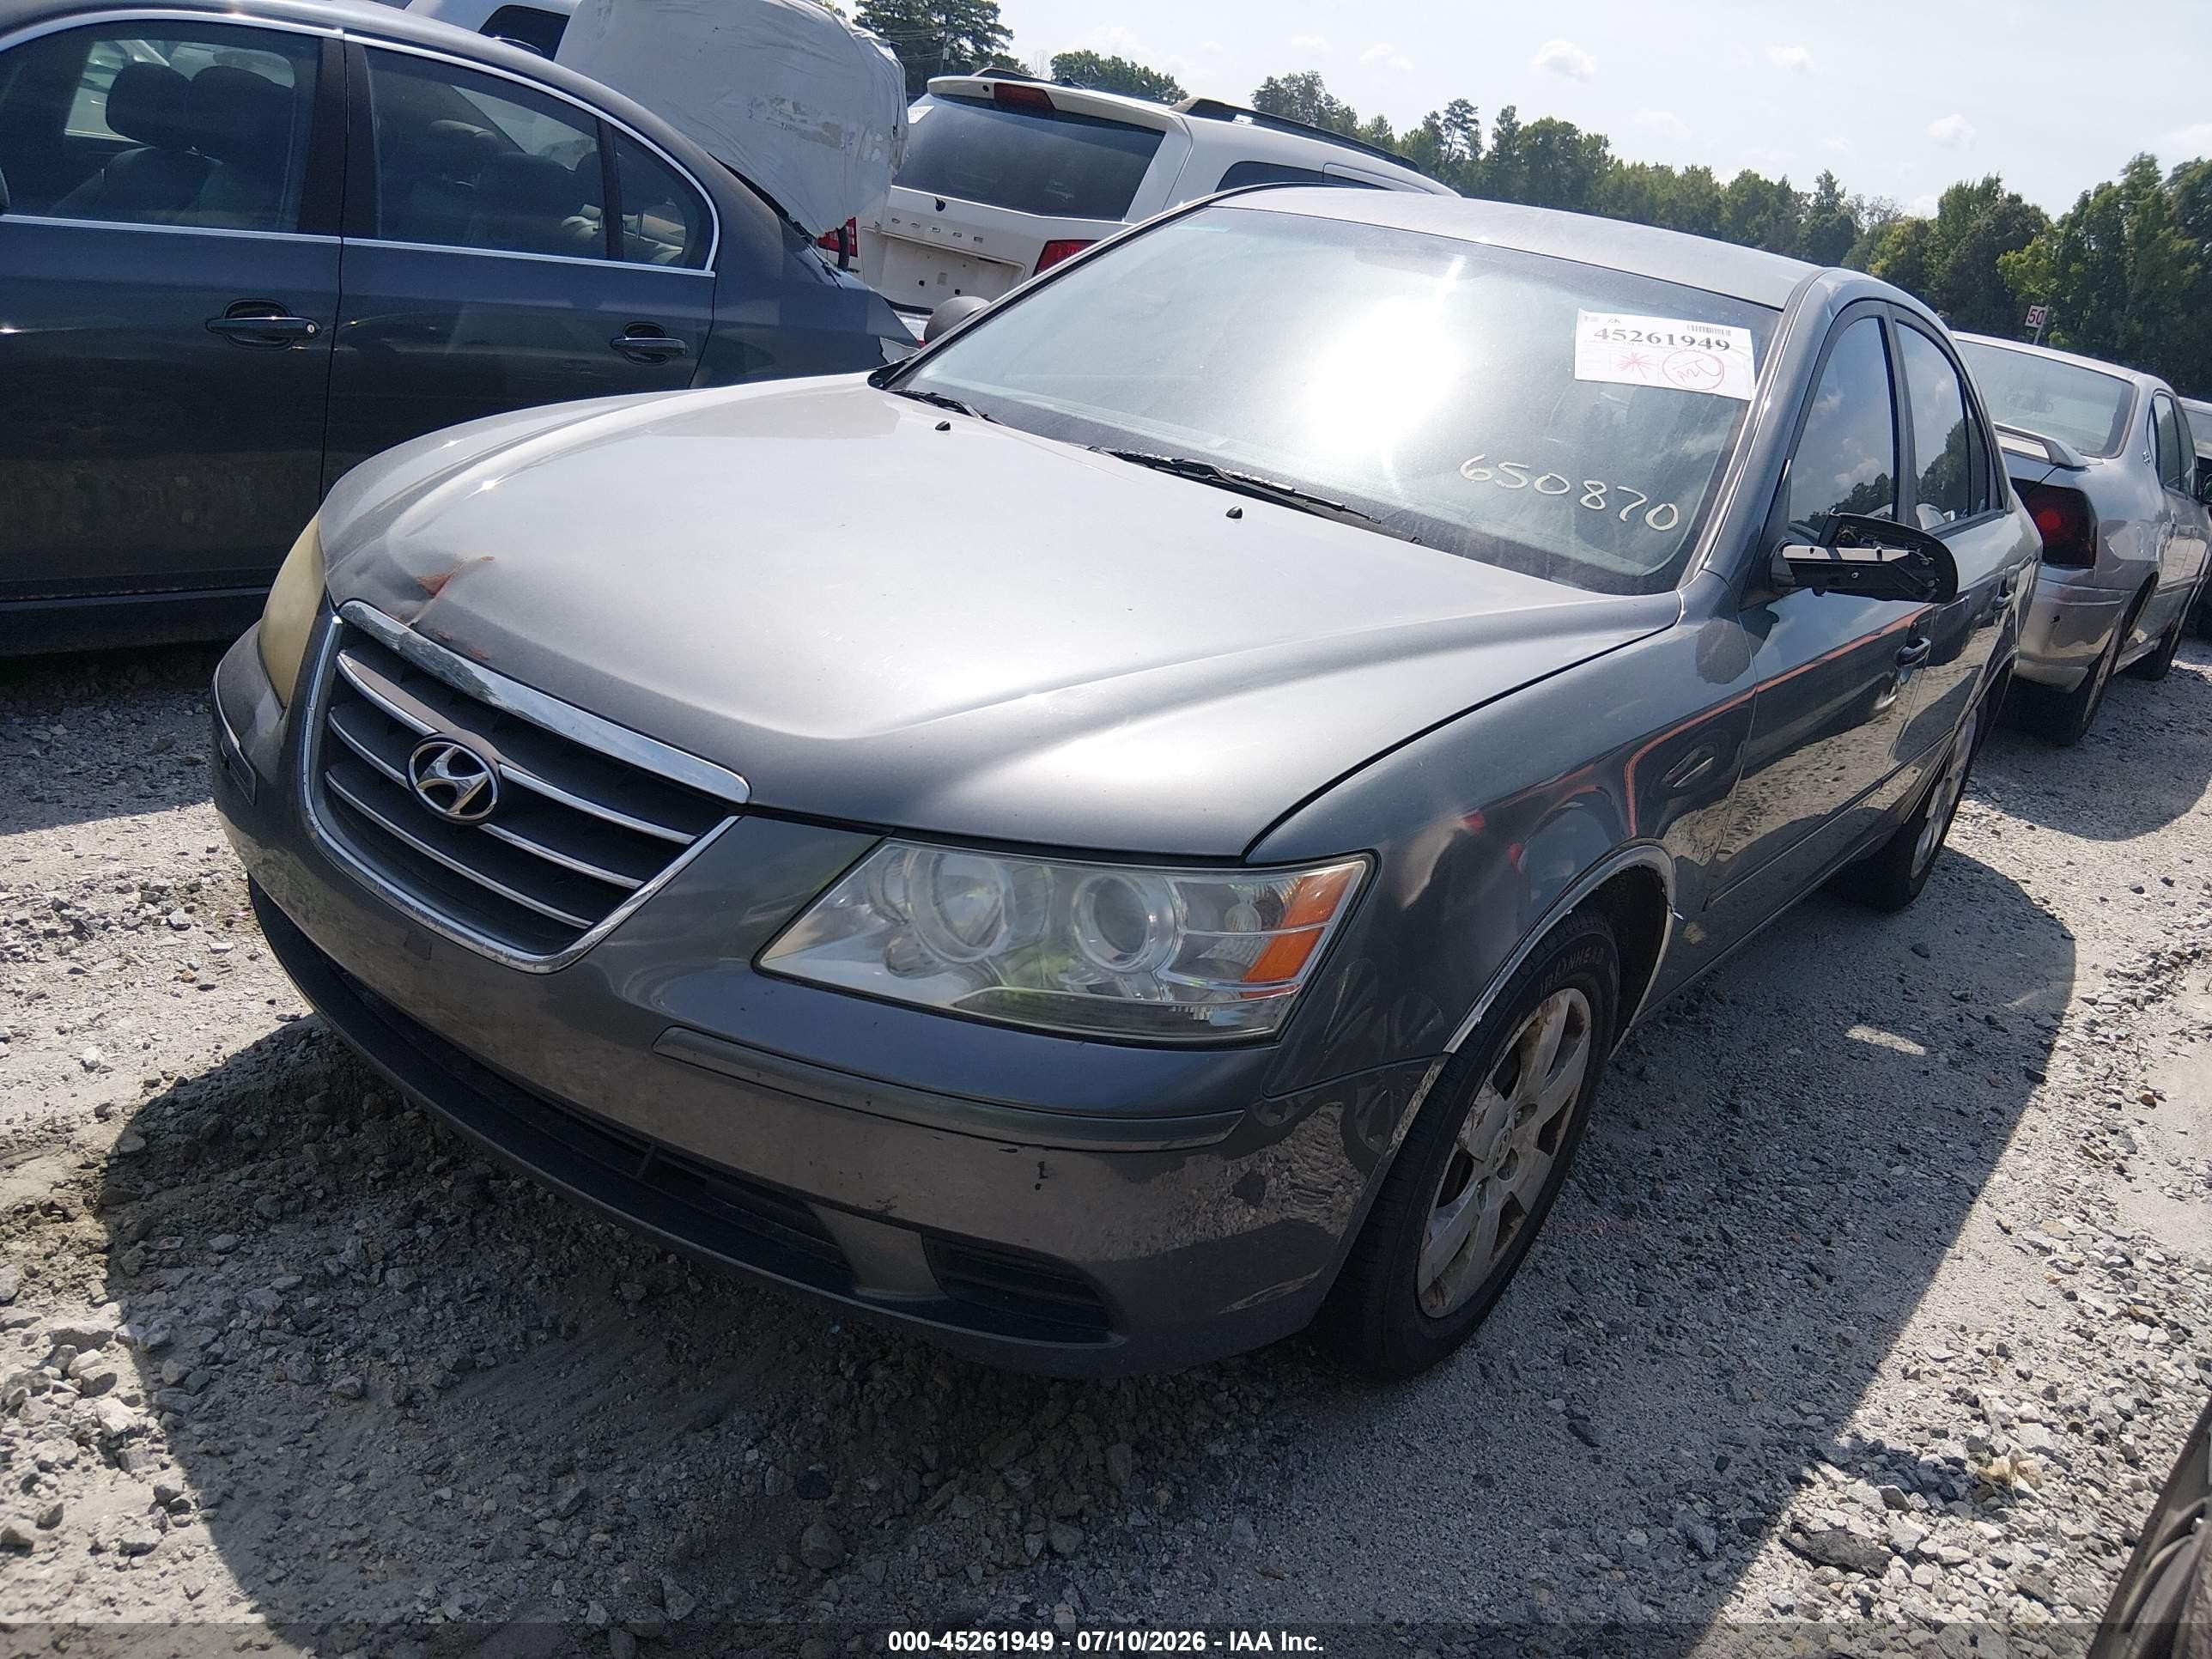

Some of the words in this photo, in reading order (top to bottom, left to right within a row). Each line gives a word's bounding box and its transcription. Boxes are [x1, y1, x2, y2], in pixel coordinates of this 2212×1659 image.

[2027, 309, 2045, 325] 50
[1593, 327, 1730, 351] 45261949
[1459, 453, 1680, 531] 650870
